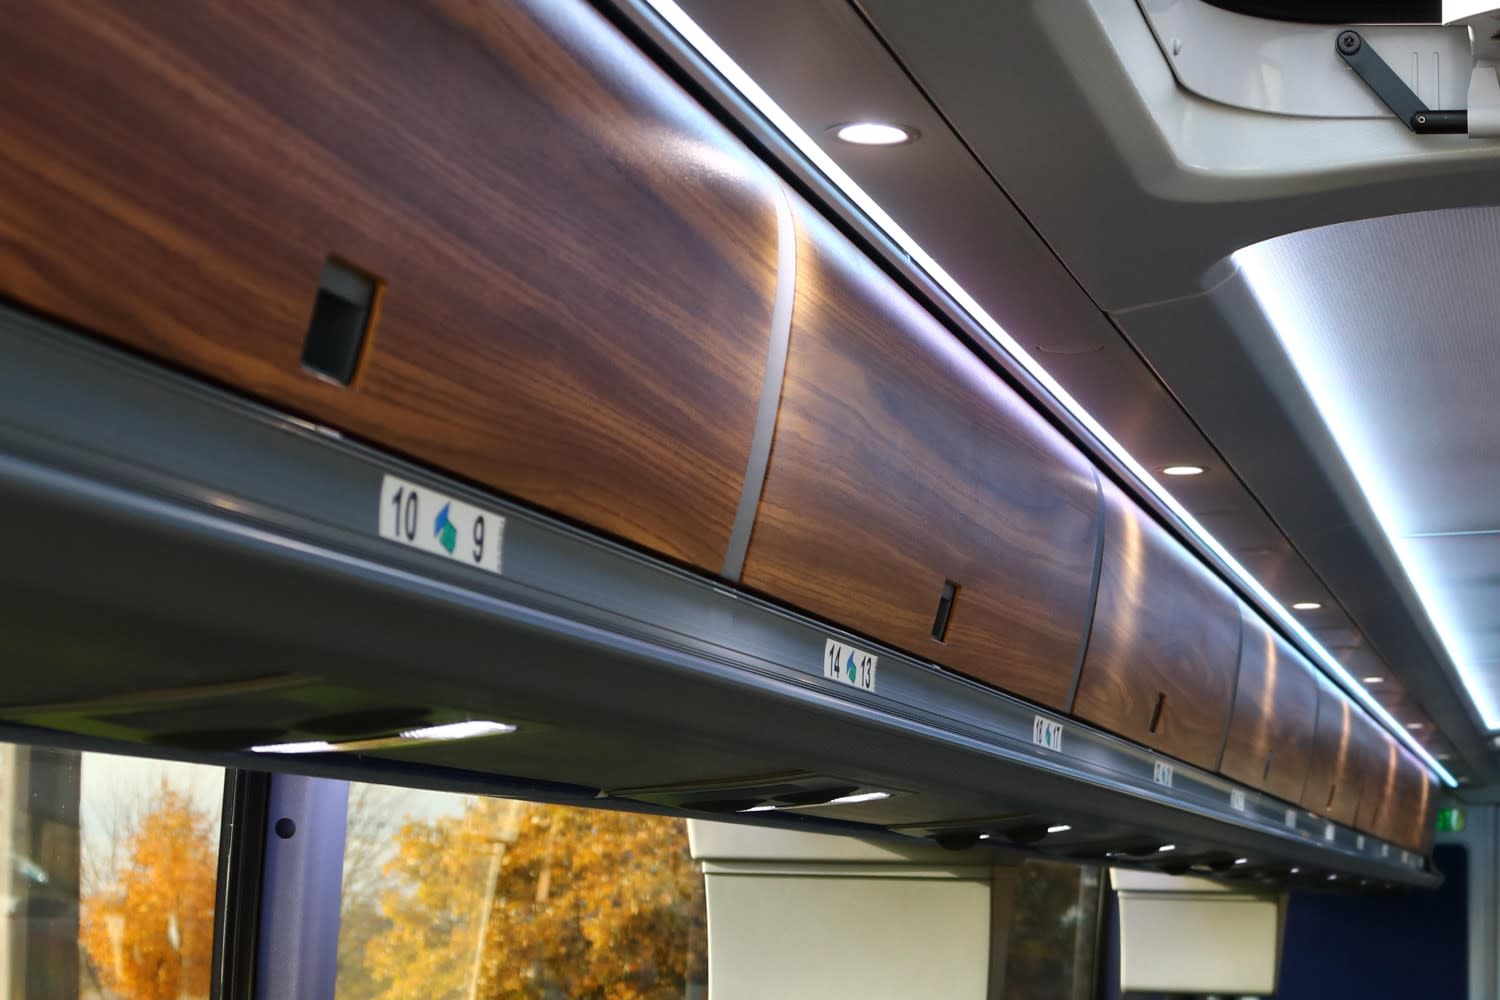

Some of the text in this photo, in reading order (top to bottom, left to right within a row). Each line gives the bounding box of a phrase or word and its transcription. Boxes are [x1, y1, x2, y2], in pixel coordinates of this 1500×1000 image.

[392, 486, 485, 563] 10 9
[829, 643, 872, 690] 14 13
